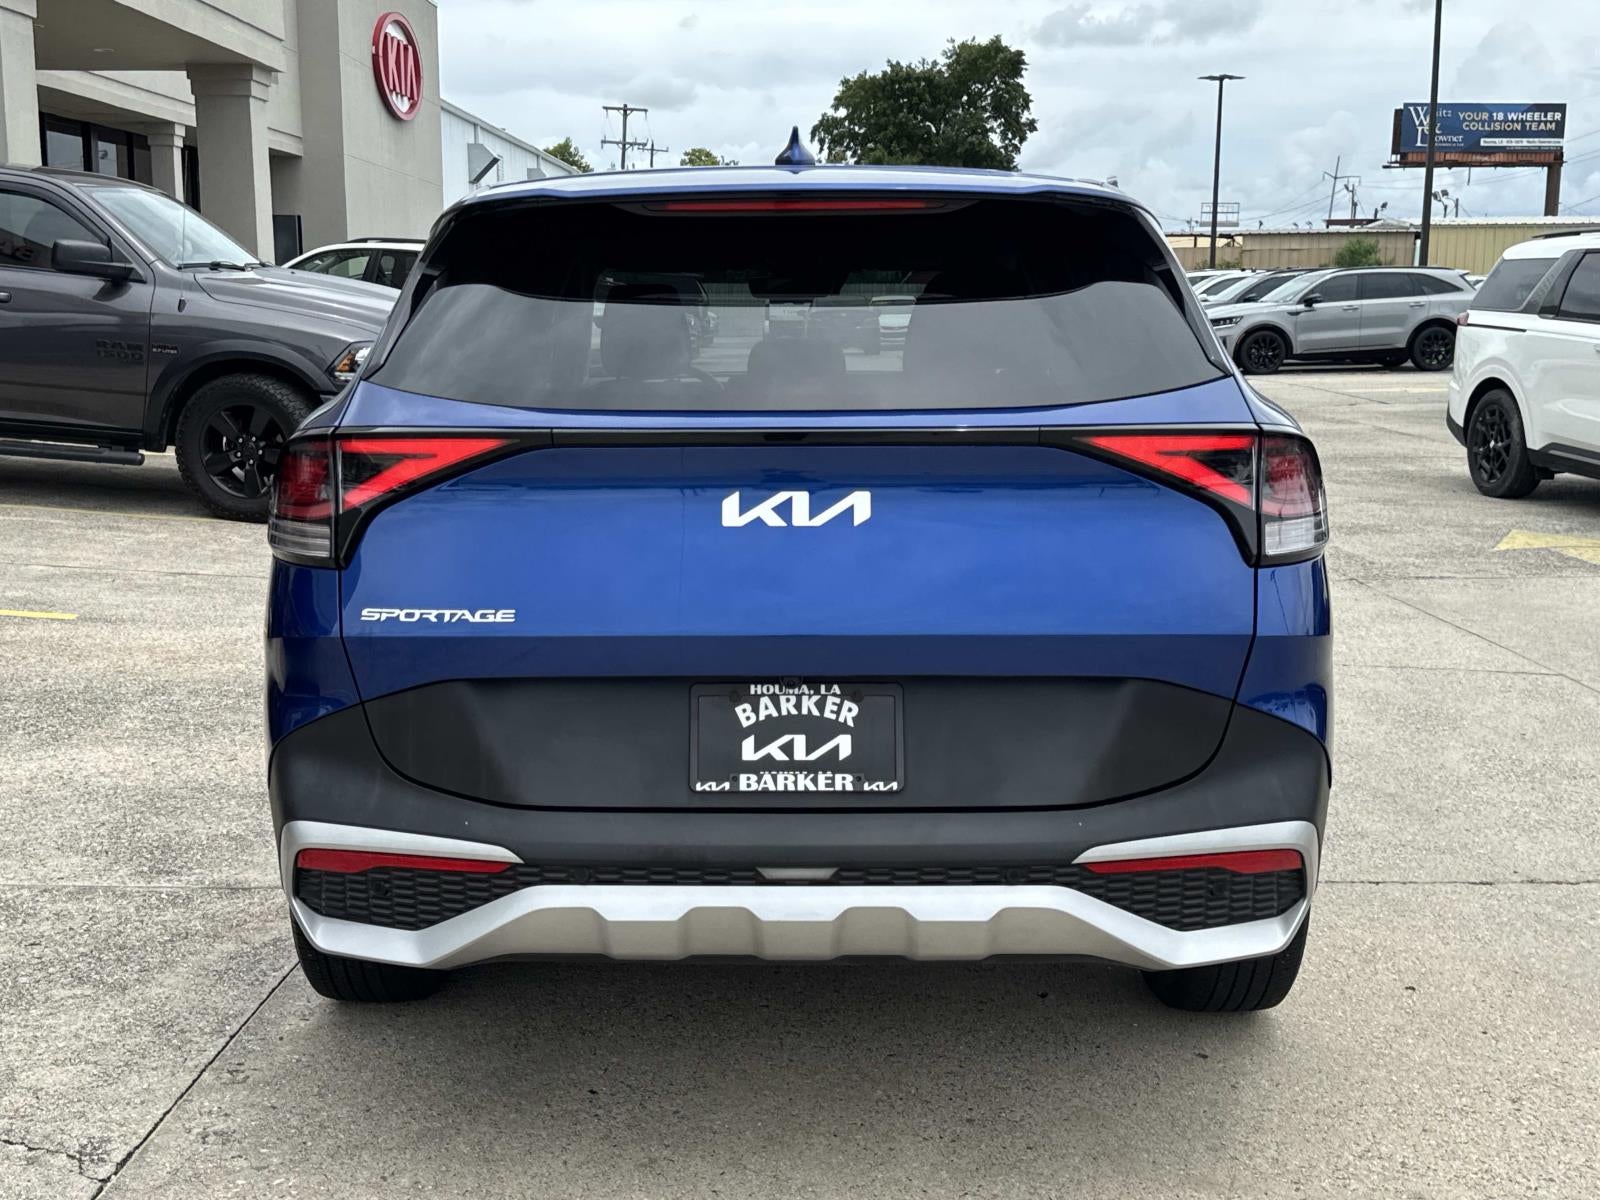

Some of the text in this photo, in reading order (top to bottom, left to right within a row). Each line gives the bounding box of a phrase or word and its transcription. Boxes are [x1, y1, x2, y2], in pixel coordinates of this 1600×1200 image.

[385, 32, 418, 101] KIA
[1458, 111, 1562, 121] YOUR 18 WHEELER
[1462, 121, 1556, 131] COLLISION TEAM
[96, 339, 145, 351] RAM
[721, 490, 872, 528] KIA
[360, 607, 516, 623] SPORTAGE
[820, 684, 841, 695] LA
[734, 695, 859, 728] BARKER
[741, 734, 852, 761] KIA
[696, 781, 730, 791] KIA
[739, 773, 853, 791] BARKER
[864, 781, 898, 791] KIA
